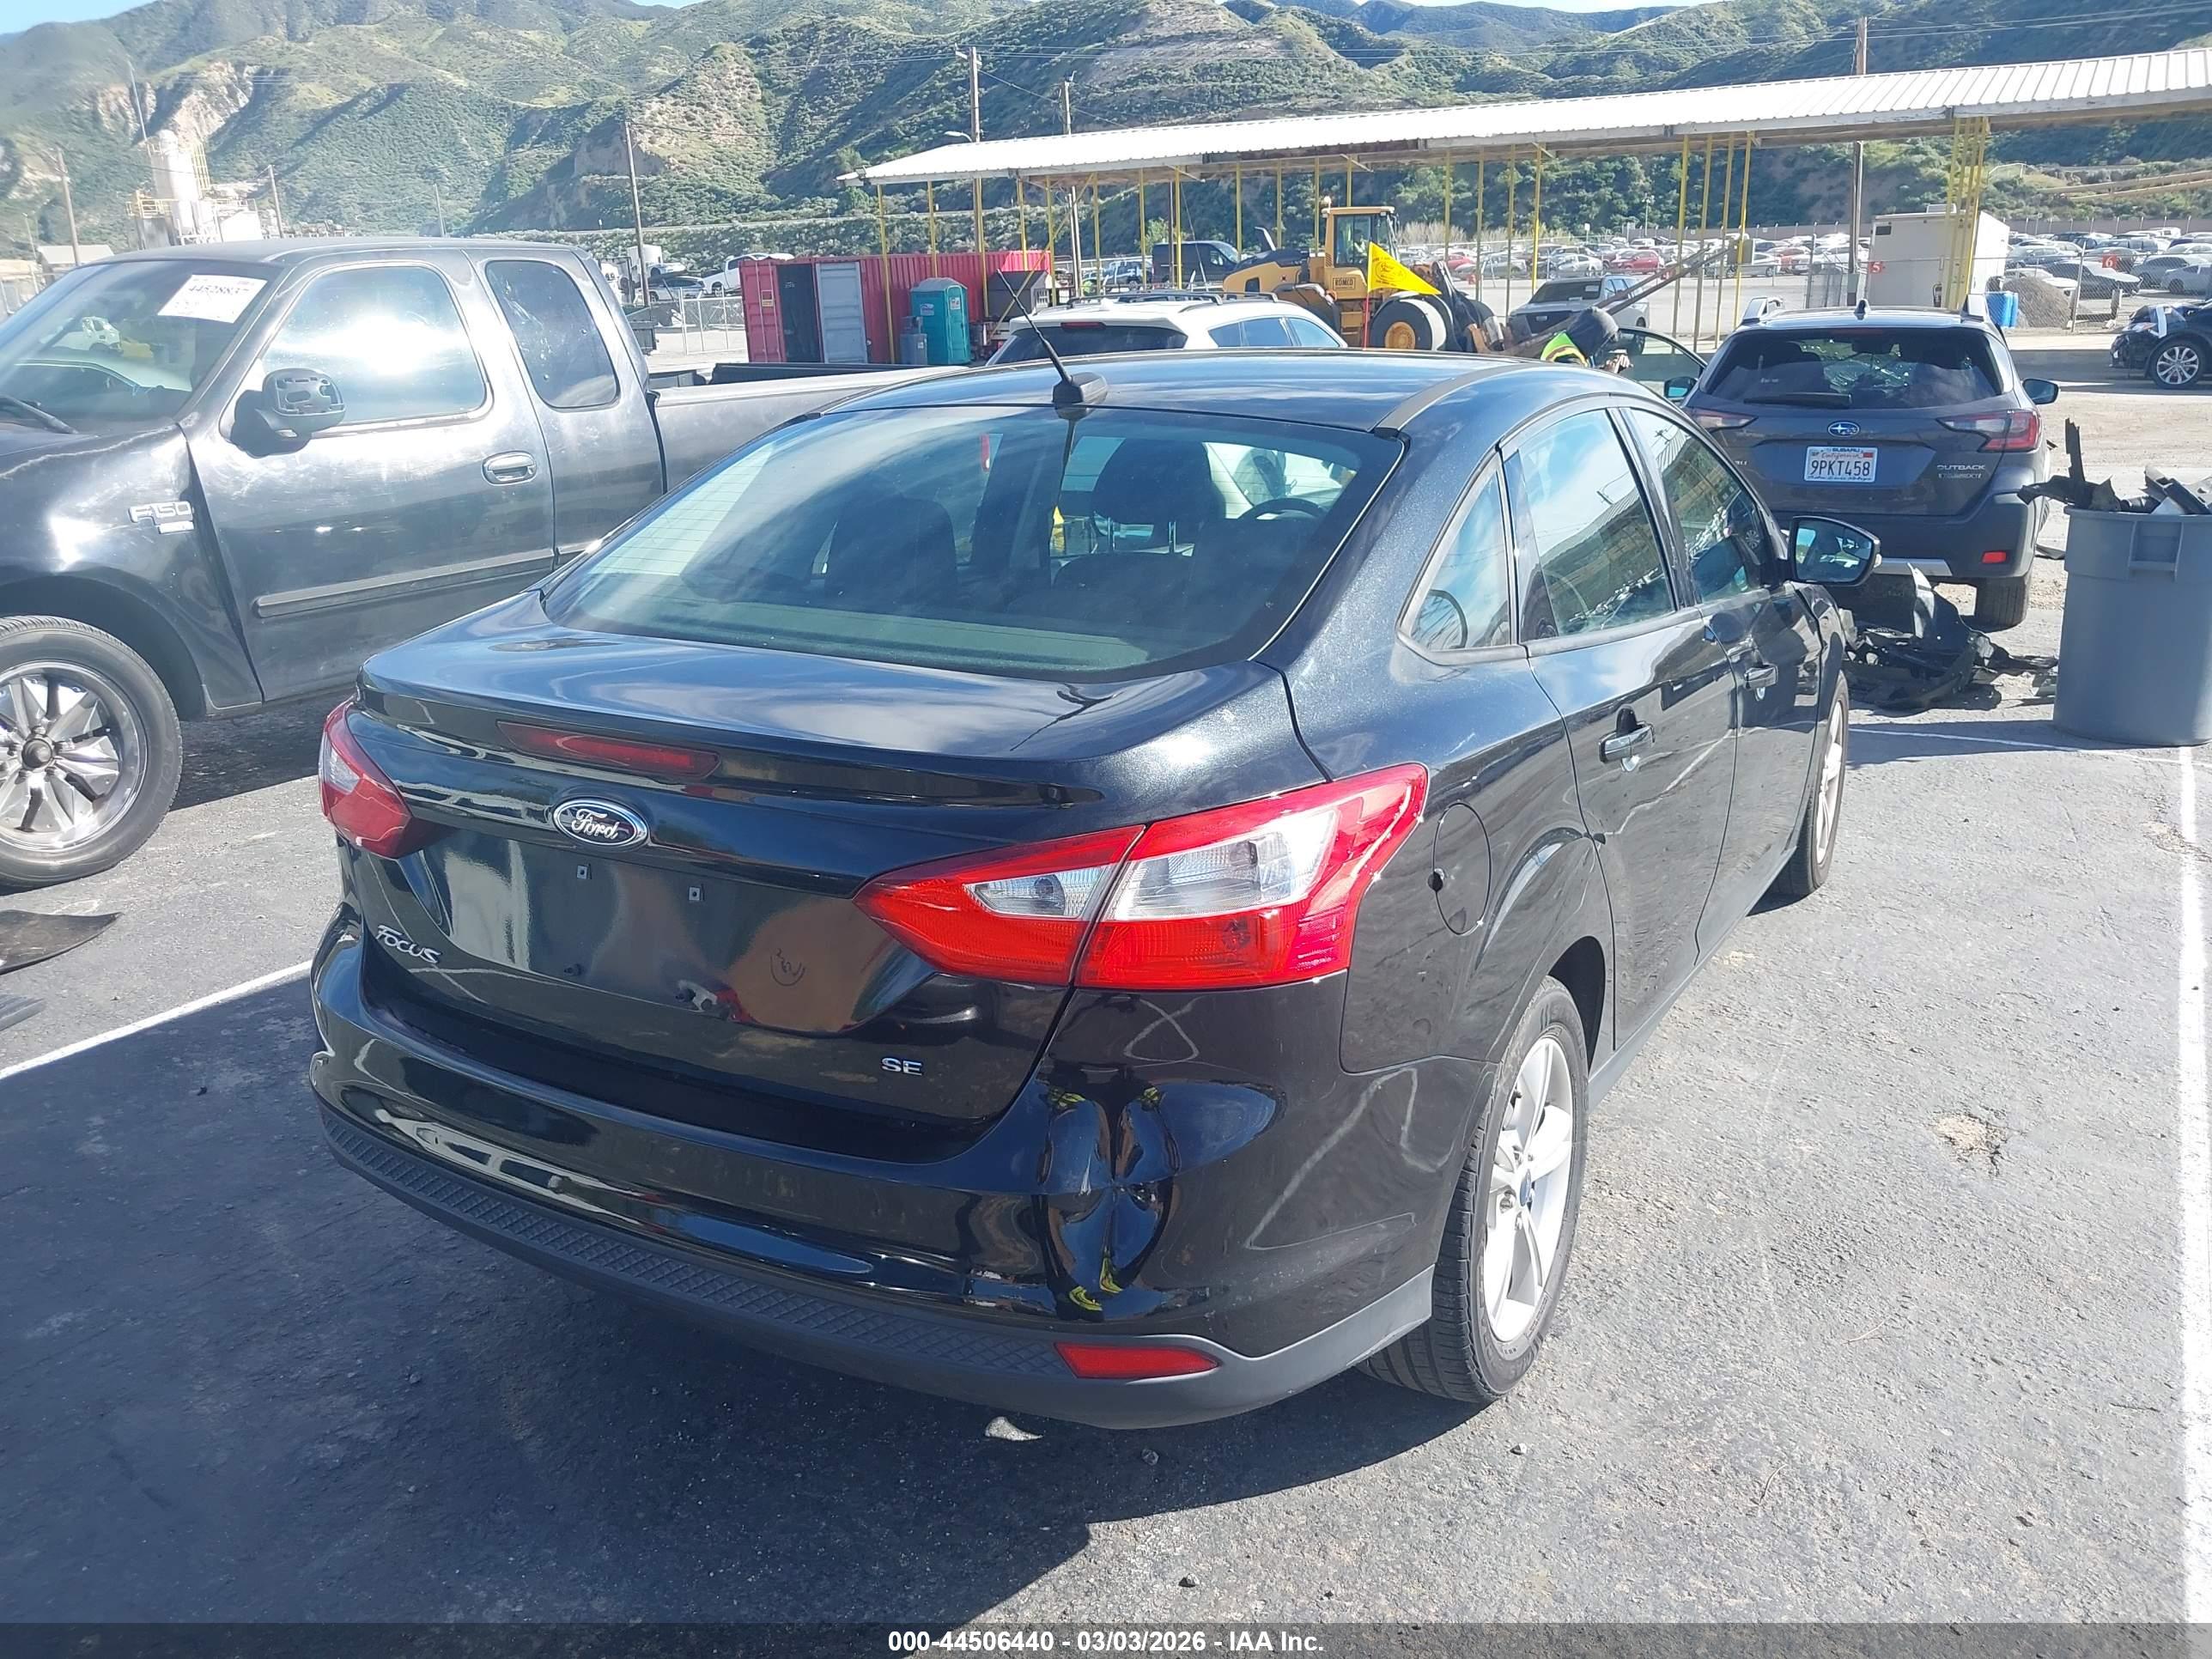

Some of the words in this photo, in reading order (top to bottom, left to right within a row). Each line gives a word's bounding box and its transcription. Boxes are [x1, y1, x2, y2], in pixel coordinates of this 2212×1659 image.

[1872, 262, 1881, 273] 5
[2106, 256, 2113, 267] 6
[1810, 460, 1870, 477] 9PKT458
[571, 809, 620, 840] Ford
[375, 925, 441, 963] FOCUS
[882, 1057, 922, 1076] SE
